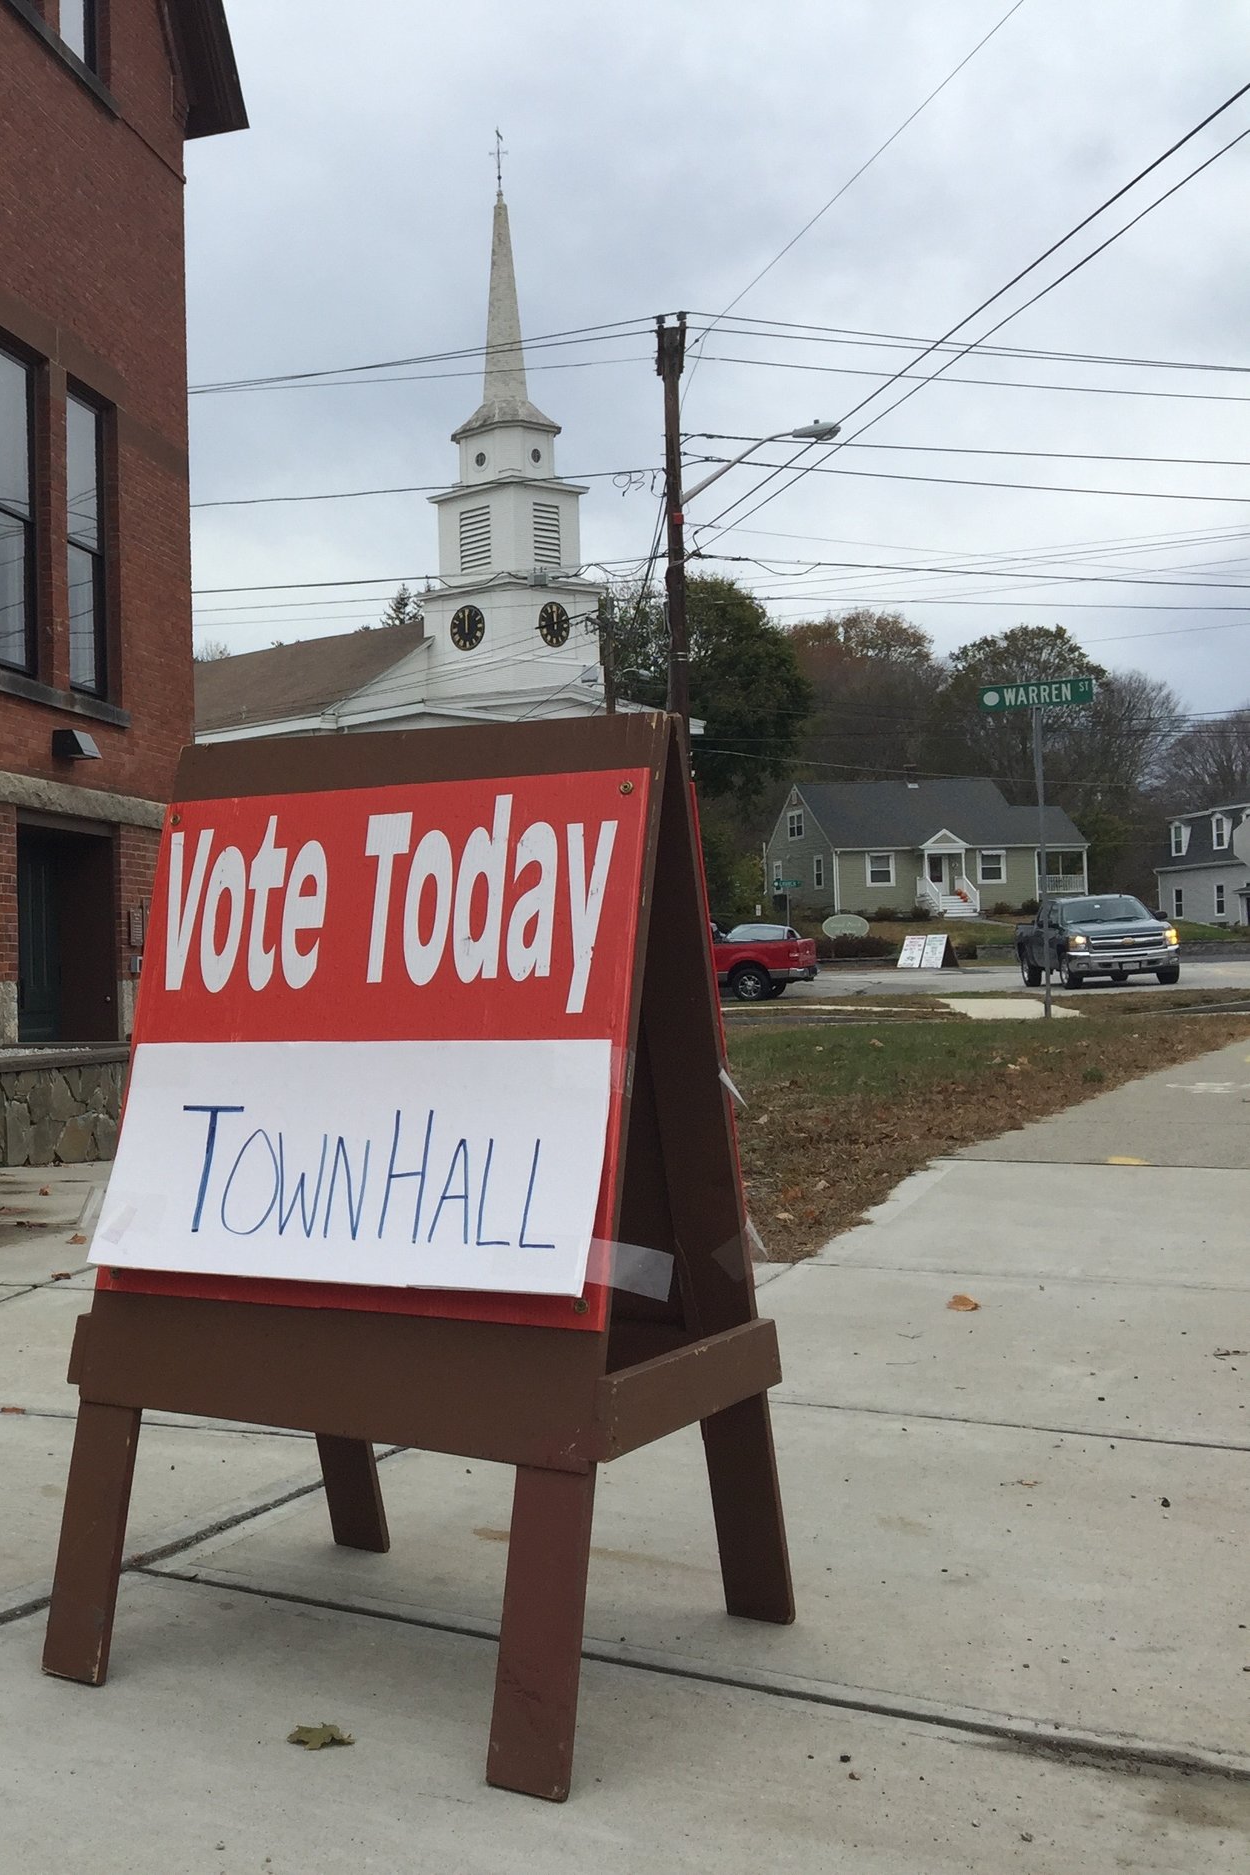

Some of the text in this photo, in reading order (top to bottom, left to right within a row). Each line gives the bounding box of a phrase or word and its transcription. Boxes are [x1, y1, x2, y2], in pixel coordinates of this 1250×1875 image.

[1003, 681, 1089, 706] WARREN ST
[165, 794, 619, 1014] Vote Today
